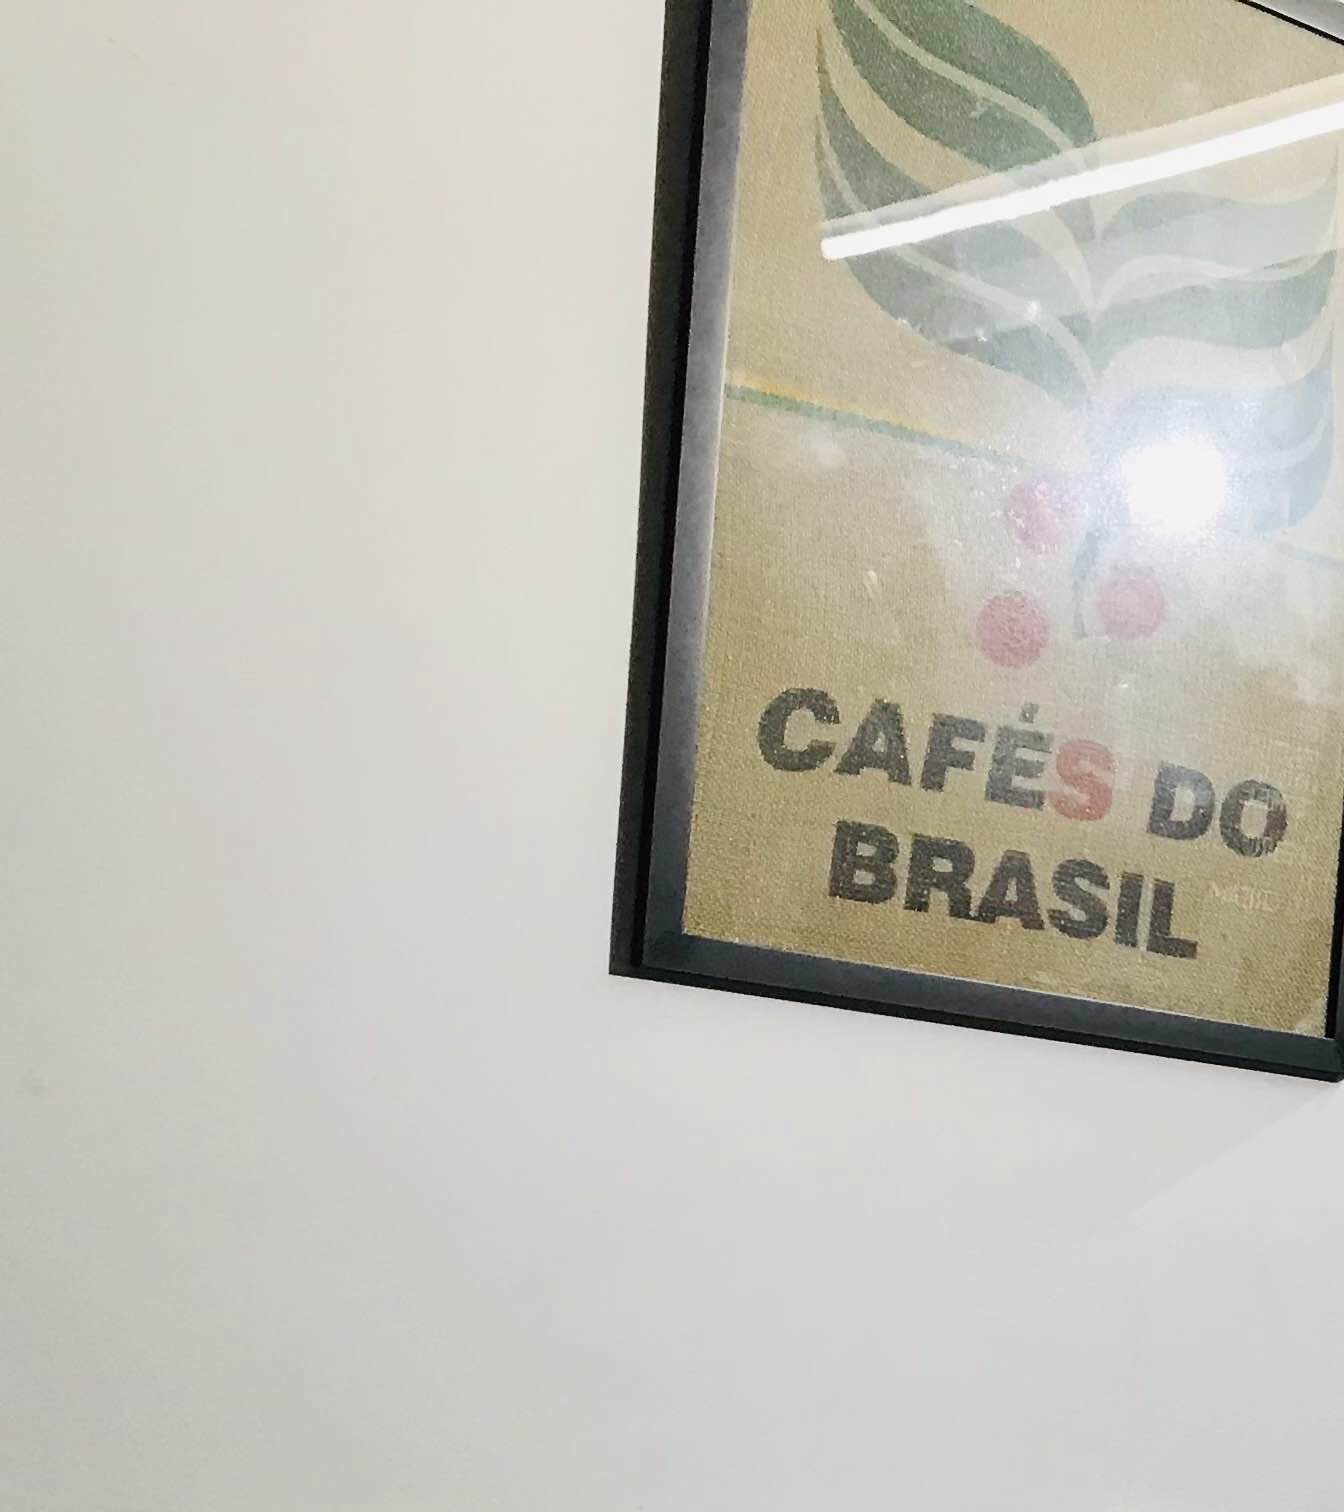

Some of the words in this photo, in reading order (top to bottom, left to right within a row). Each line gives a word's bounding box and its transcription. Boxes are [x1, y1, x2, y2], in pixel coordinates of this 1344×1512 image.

[757, 686, 1118, 822] CAFÉS
[1145, 760, 1288, 858] DO
[828, 819, 1198, 960] BRASIL
